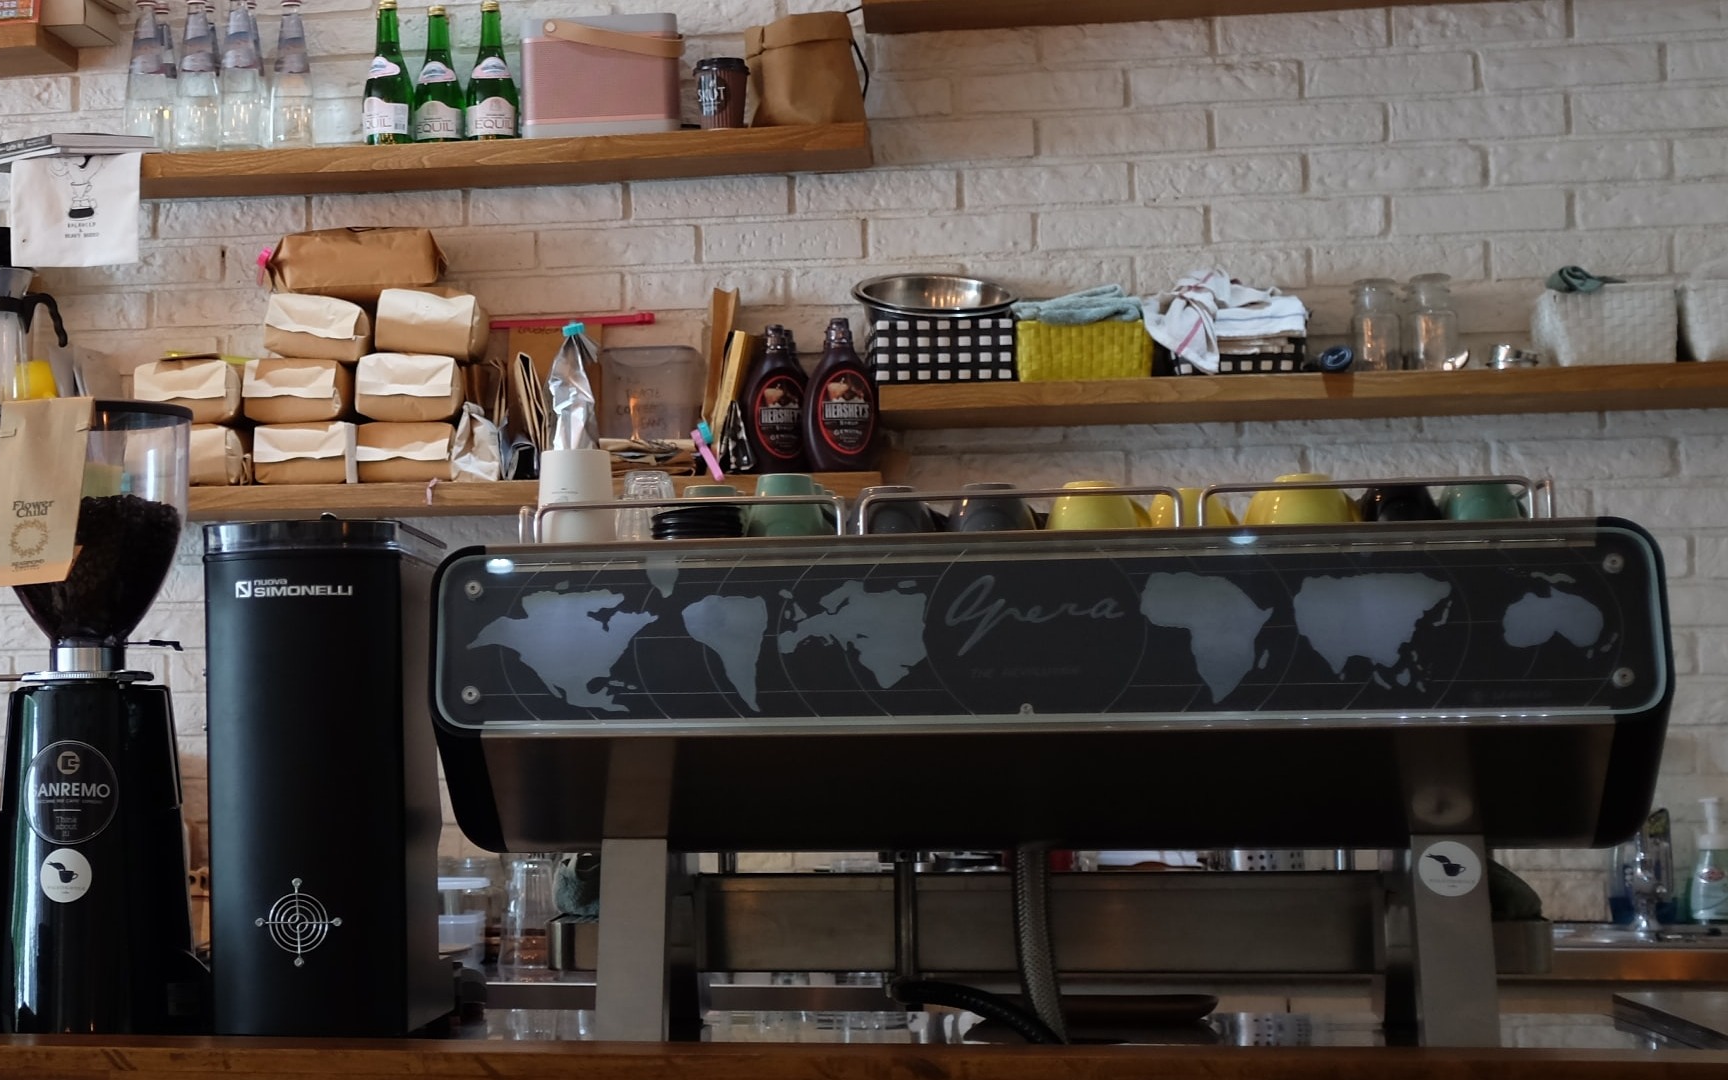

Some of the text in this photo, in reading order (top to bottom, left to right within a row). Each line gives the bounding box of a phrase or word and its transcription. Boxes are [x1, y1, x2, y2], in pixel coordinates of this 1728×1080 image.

[475, 119, 513, 130] EQUIL
[824, 403, 869, 419] HERSHEY'S
[12, 500, 55, 511] Flower
[16, 506, 48, 518] Child
[253, 578, 288, 586] nuova
[253, 585, 353, 598] SIMONELLI
